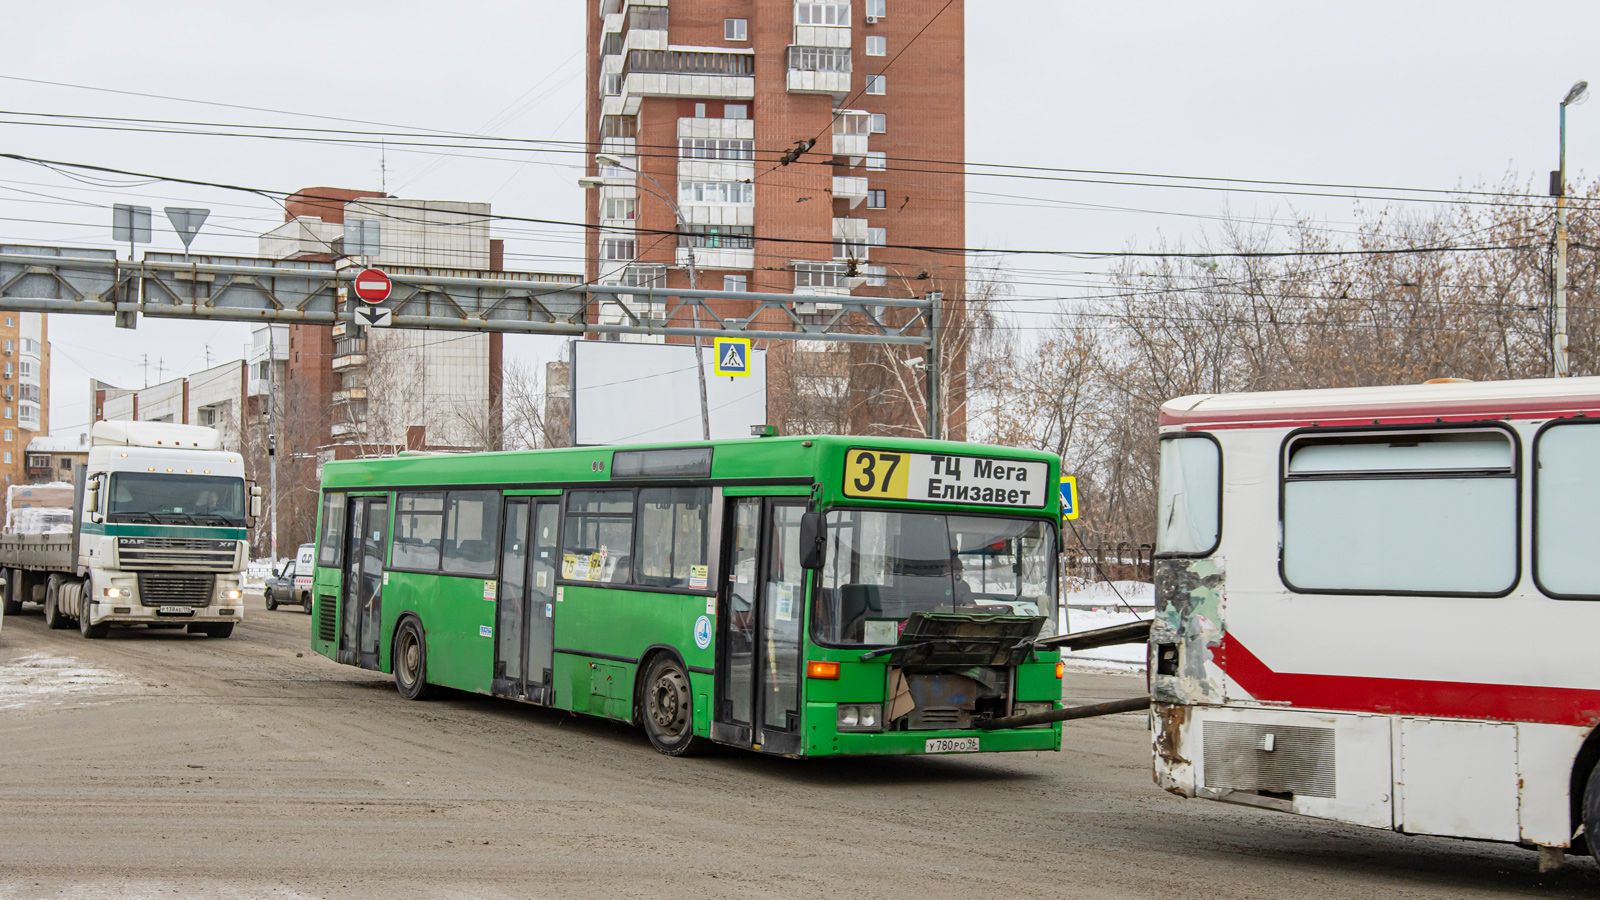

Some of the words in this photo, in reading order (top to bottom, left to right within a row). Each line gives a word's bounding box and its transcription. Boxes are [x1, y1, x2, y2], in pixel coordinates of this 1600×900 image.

[854, 452, 901, 492] 37
[930, 455, 961, 481] ТЦ
[973, 459, 1028, 482] Мега
[927, 478, 1031, 504] Елизавет
